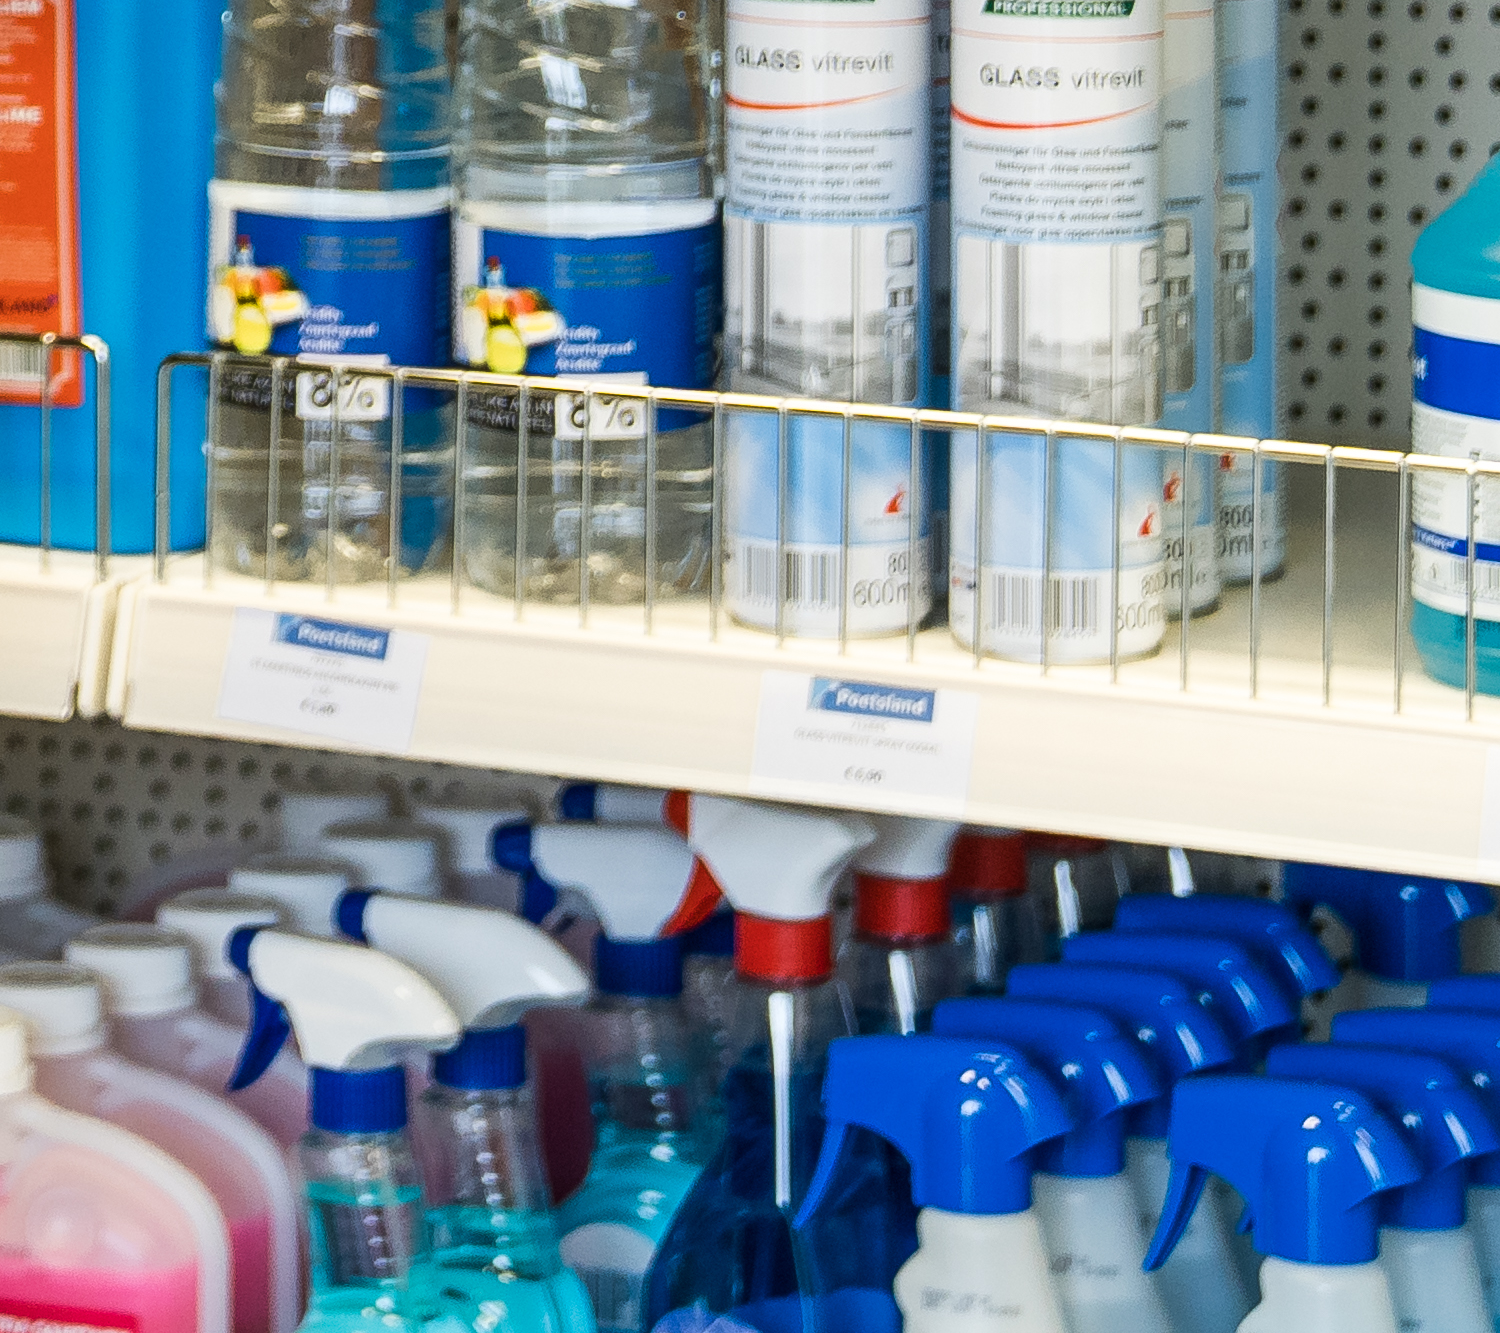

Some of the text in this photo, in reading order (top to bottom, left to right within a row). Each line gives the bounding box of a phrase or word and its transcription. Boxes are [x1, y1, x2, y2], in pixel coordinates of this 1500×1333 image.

[993, 0, 1128, 16] PROFESSIONAL
[735, 45, 894, 73] GLASS vitrevit
[980, 64, 1146, 89] GLASS vitrevit
[836, 688, 927, 716] Poetsland
